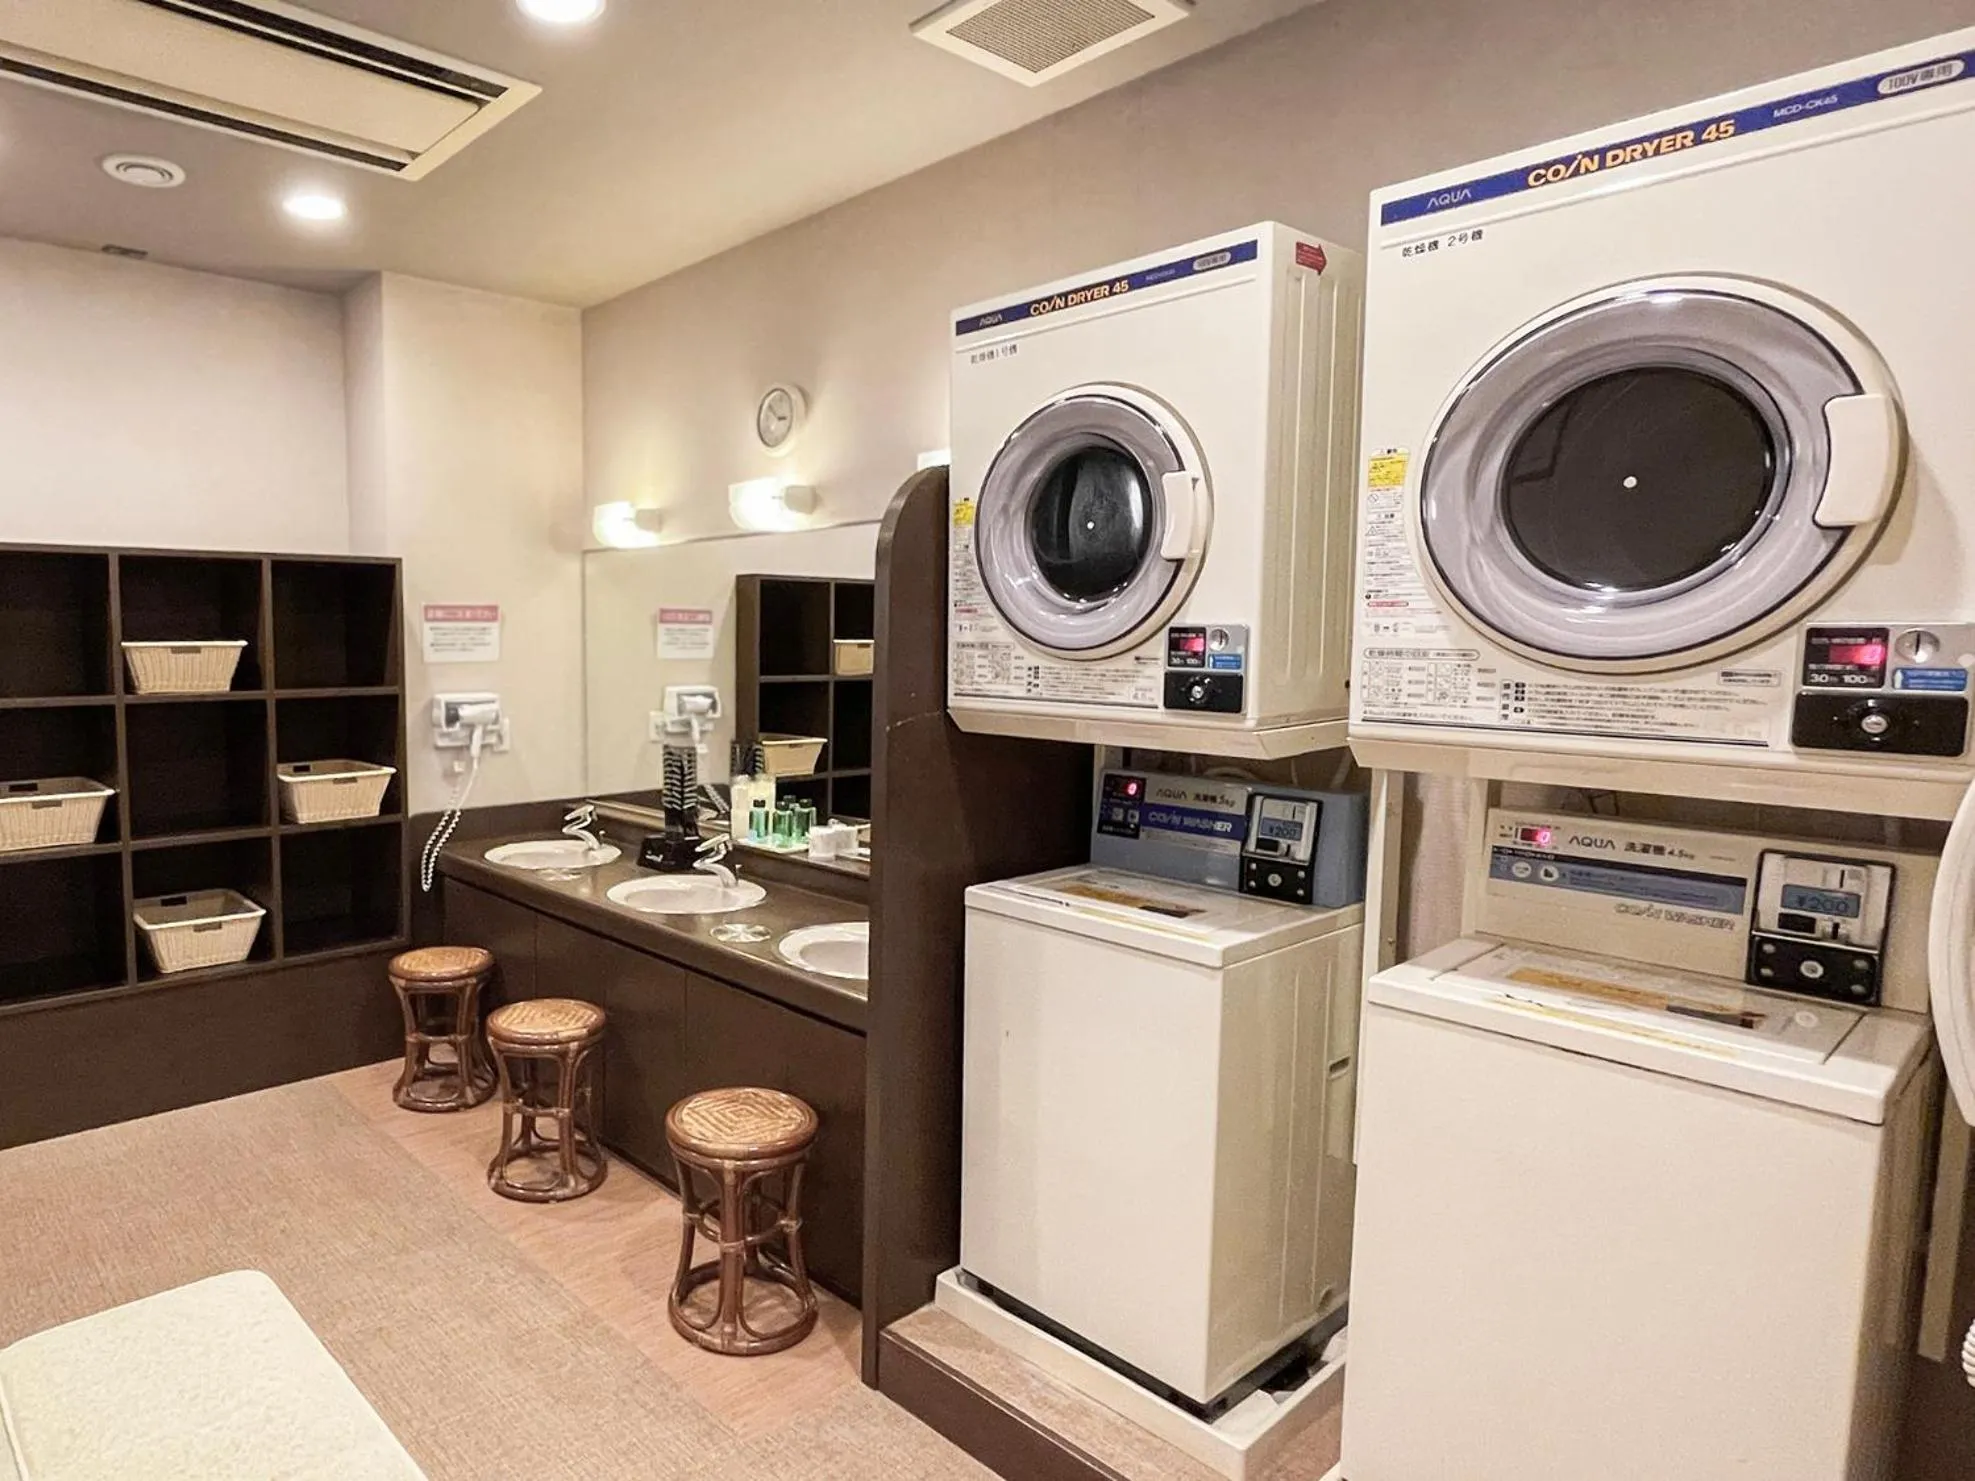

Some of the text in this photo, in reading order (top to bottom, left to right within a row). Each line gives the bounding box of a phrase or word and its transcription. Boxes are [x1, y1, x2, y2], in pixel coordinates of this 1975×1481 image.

[1606, 130, 1695, 167] DRYER
[1702, 119, 1736, 142] 45
[1427, 188, 1472, 210] AQUA
[1067, 285, 1110, 306] DRYER
[1112, 279, 1130, 294] 45
[1569, 835, 1616, 851] AQUA
